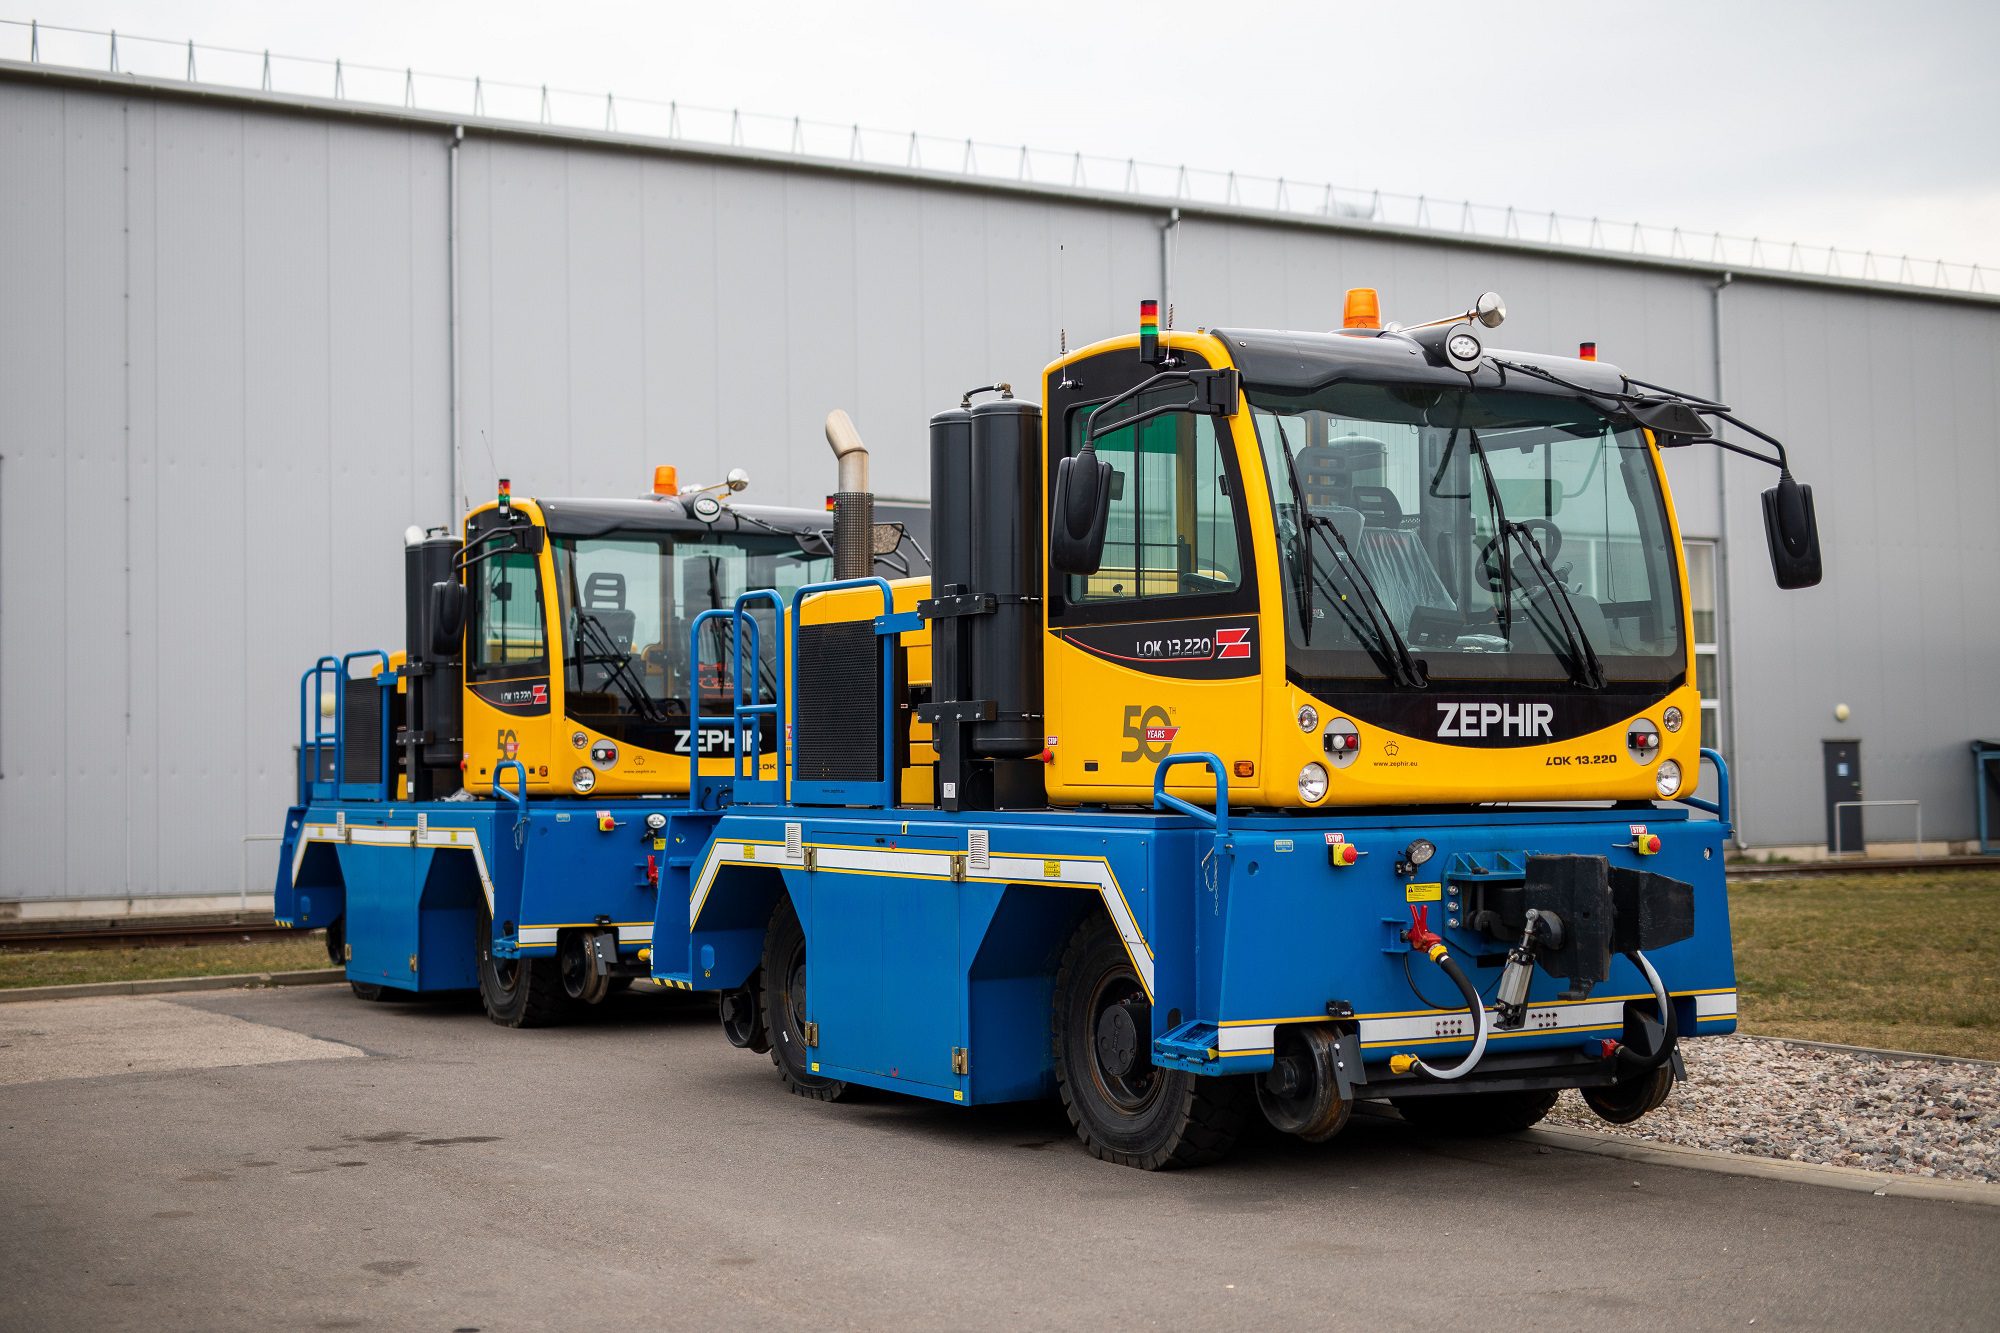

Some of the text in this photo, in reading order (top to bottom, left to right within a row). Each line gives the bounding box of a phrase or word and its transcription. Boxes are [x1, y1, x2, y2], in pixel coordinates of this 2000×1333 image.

[1136, 637, 1211, 657] LOK 13.220
[1436, 702, 1554, 737] ZEPHIR
[1121, 705, 1173, 764] 50
[1147, 729, 1166, 739] YEARS
[1545, 754, 1617, 766] LOK 13.220
[1327, 833, 1343, 843] STOP
